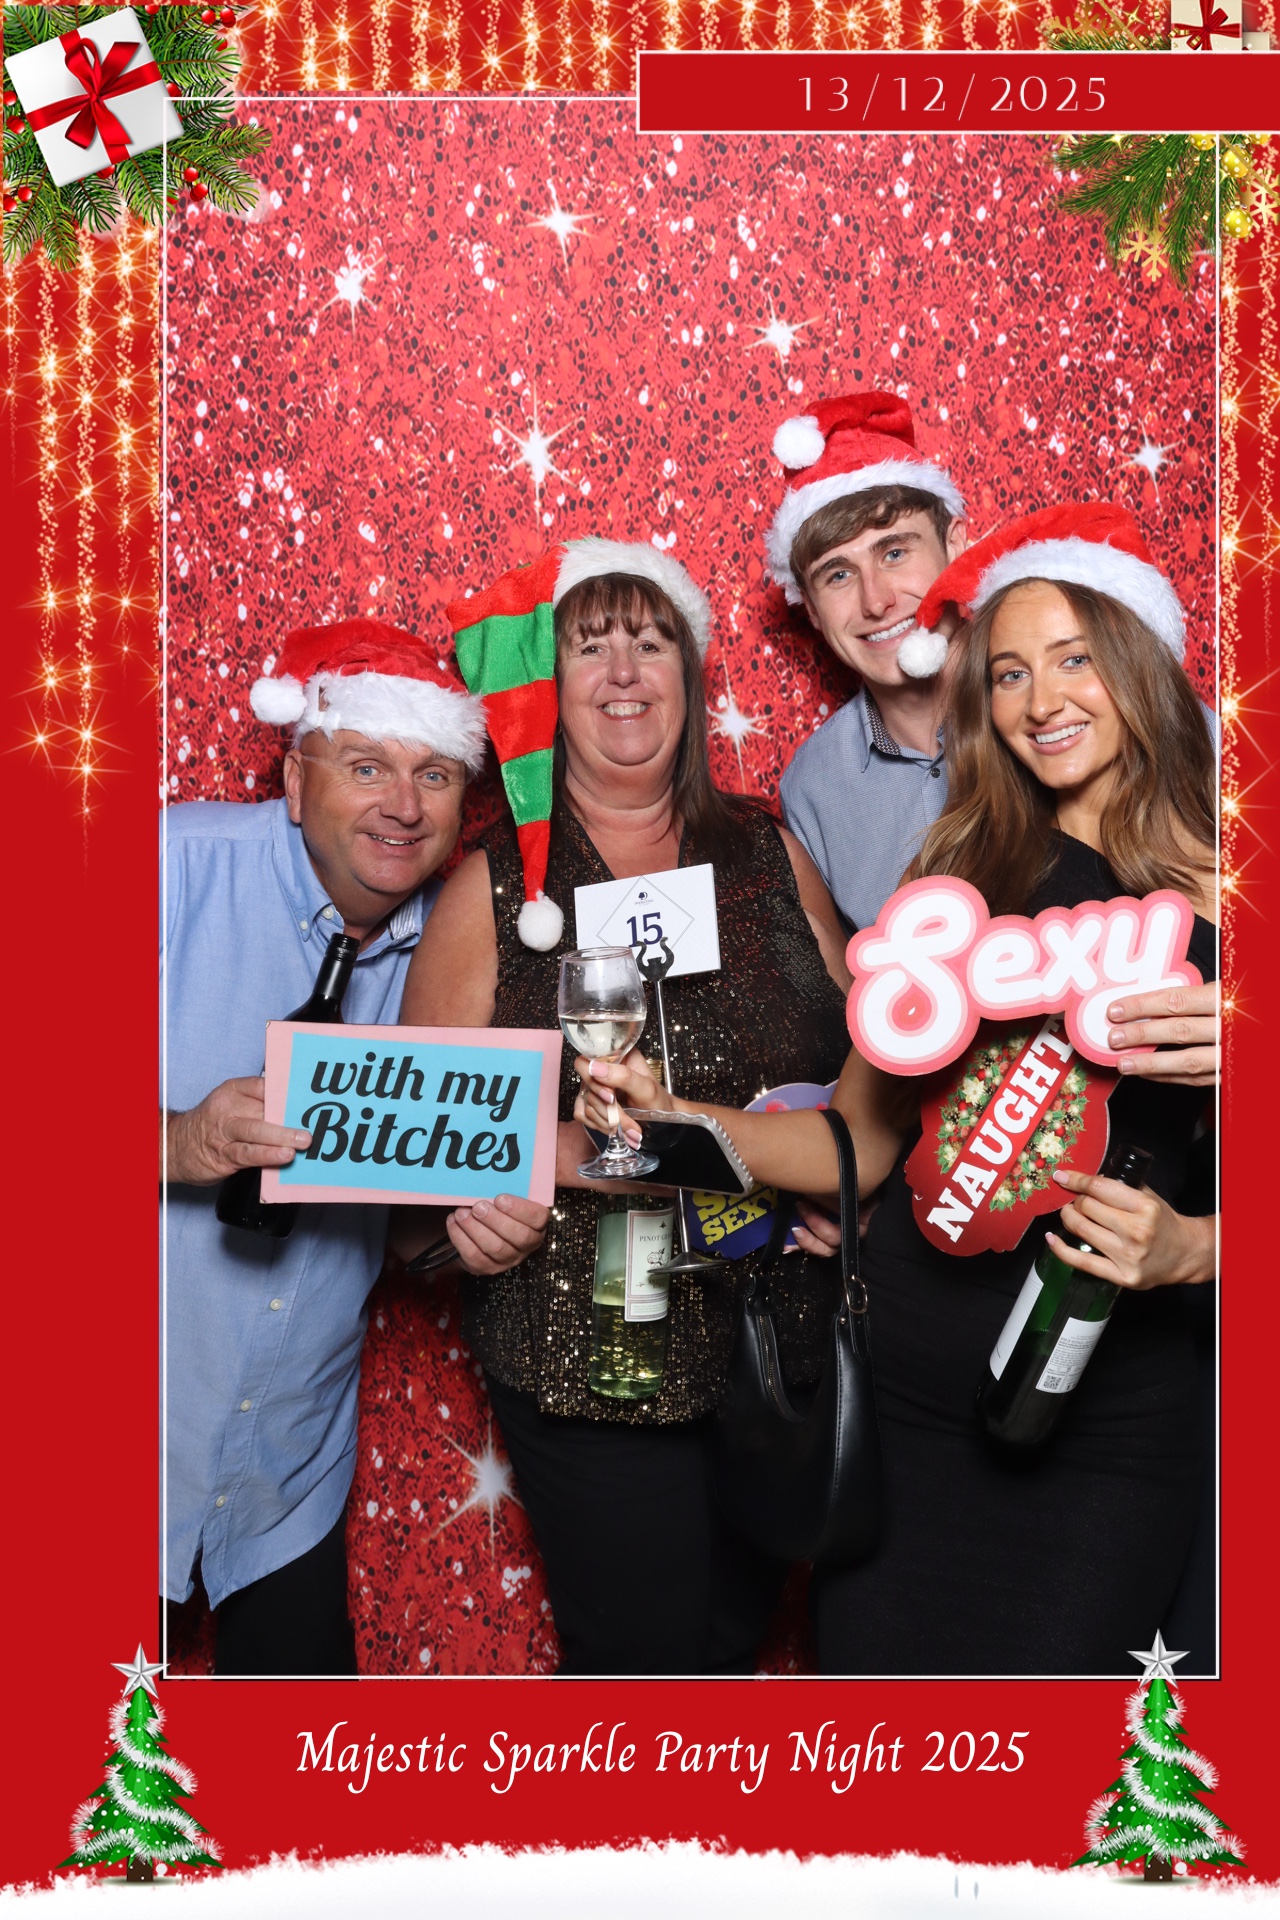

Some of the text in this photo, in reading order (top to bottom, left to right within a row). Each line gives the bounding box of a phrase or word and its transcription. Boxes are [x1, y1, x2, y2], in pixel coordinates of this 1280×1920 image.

[626, 911, 664, 948] 15
[862, 893, 1185, 1060] Sexy
[310, 1051, 521, 1122] with my
[301, 1101, 521, 1172] Bitches
[926, 1011, 1076, 1243] NAUGHT
[639, 1234, 660, 1242] PINOT
